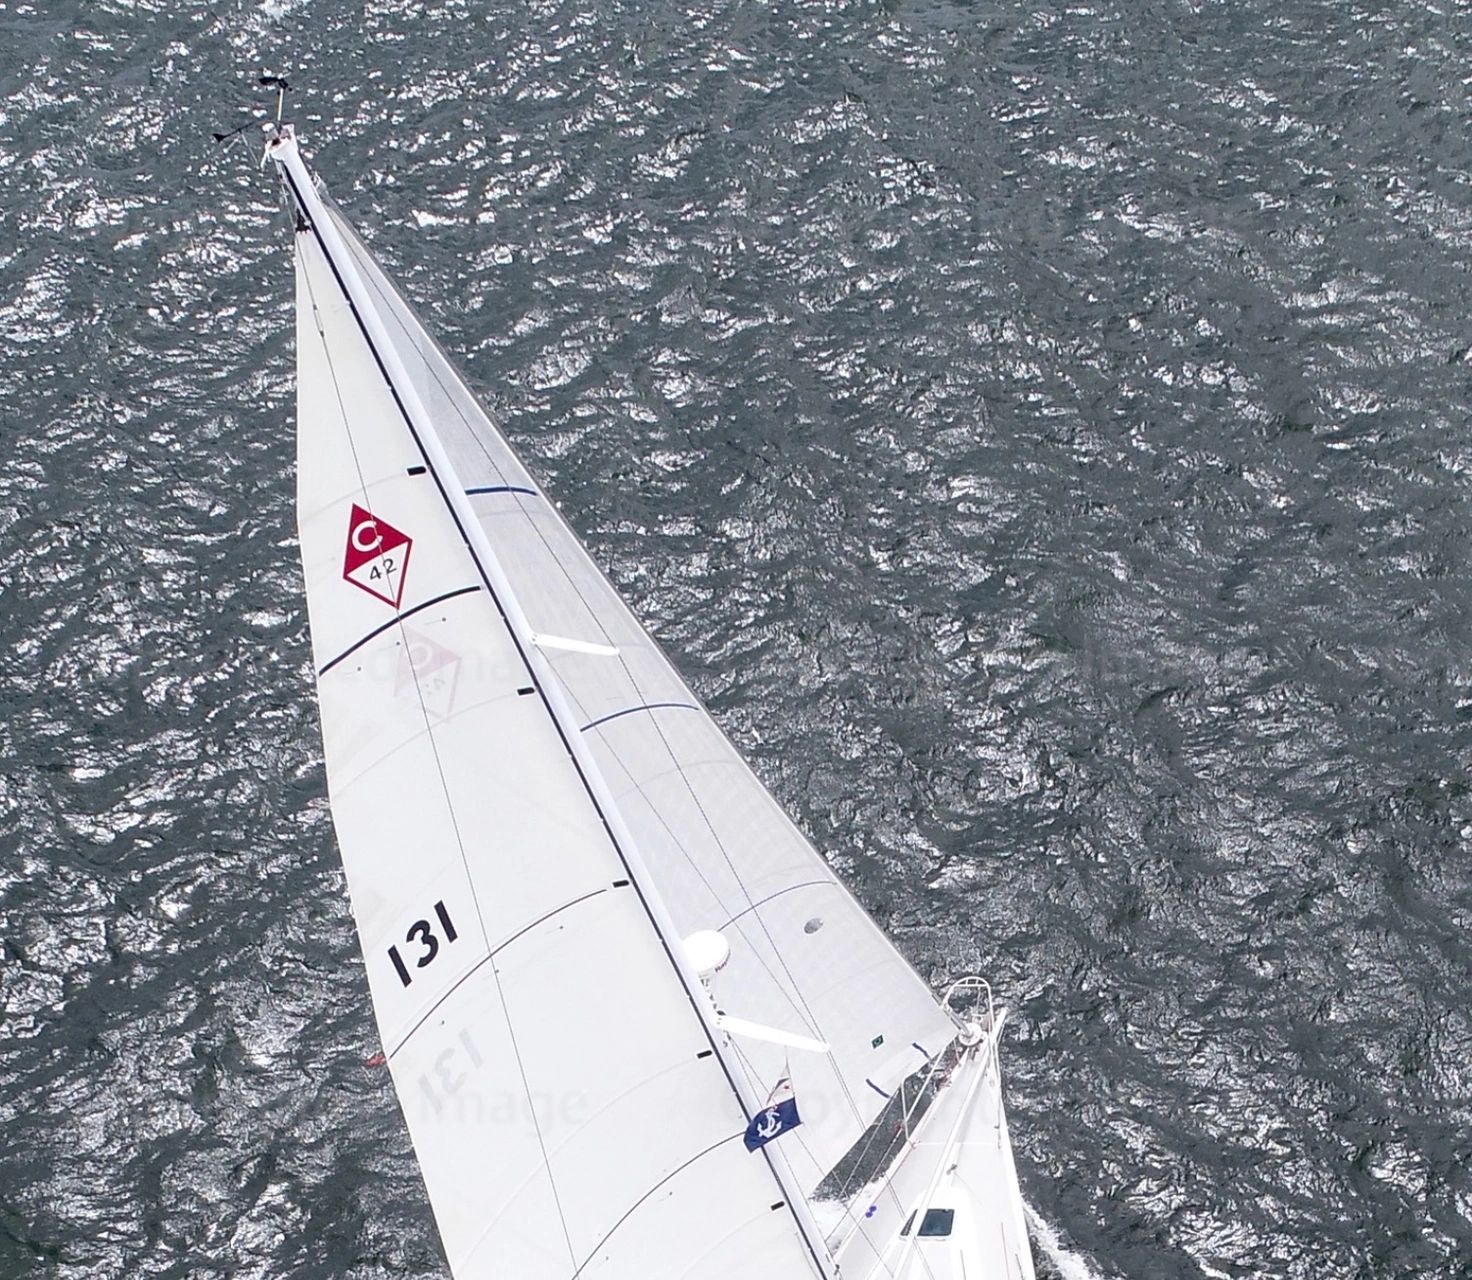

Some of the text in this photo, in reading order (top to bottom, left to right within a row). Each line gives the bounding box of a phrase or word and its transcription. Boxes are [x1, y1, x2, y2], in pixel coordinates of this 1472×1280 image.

[352, 520, 383, 552] C
[370, 558, 397, 581] 42
[387, 900, 459, 988] 131
